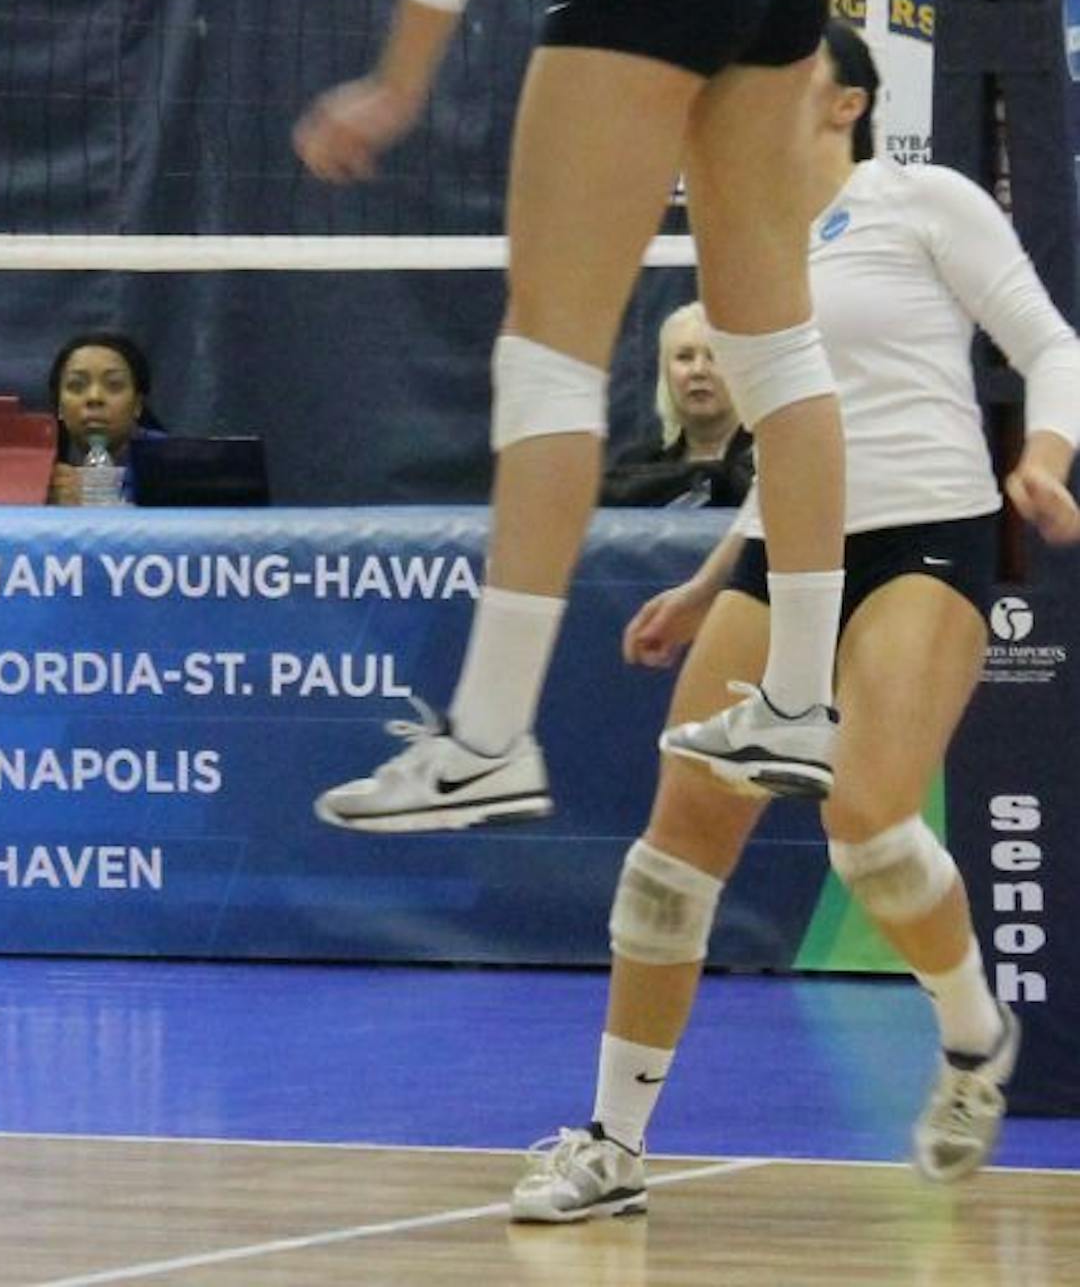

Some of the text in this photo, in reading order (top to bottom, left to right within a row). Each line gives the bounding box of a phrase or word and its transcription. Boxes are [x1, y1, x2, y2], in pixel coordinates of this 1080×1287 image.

[101, 555, 482, 600] YOUNG-HAWA
[271, 653, 412, 698] PAUL
[988, 794, 1048, 1003] senoh
